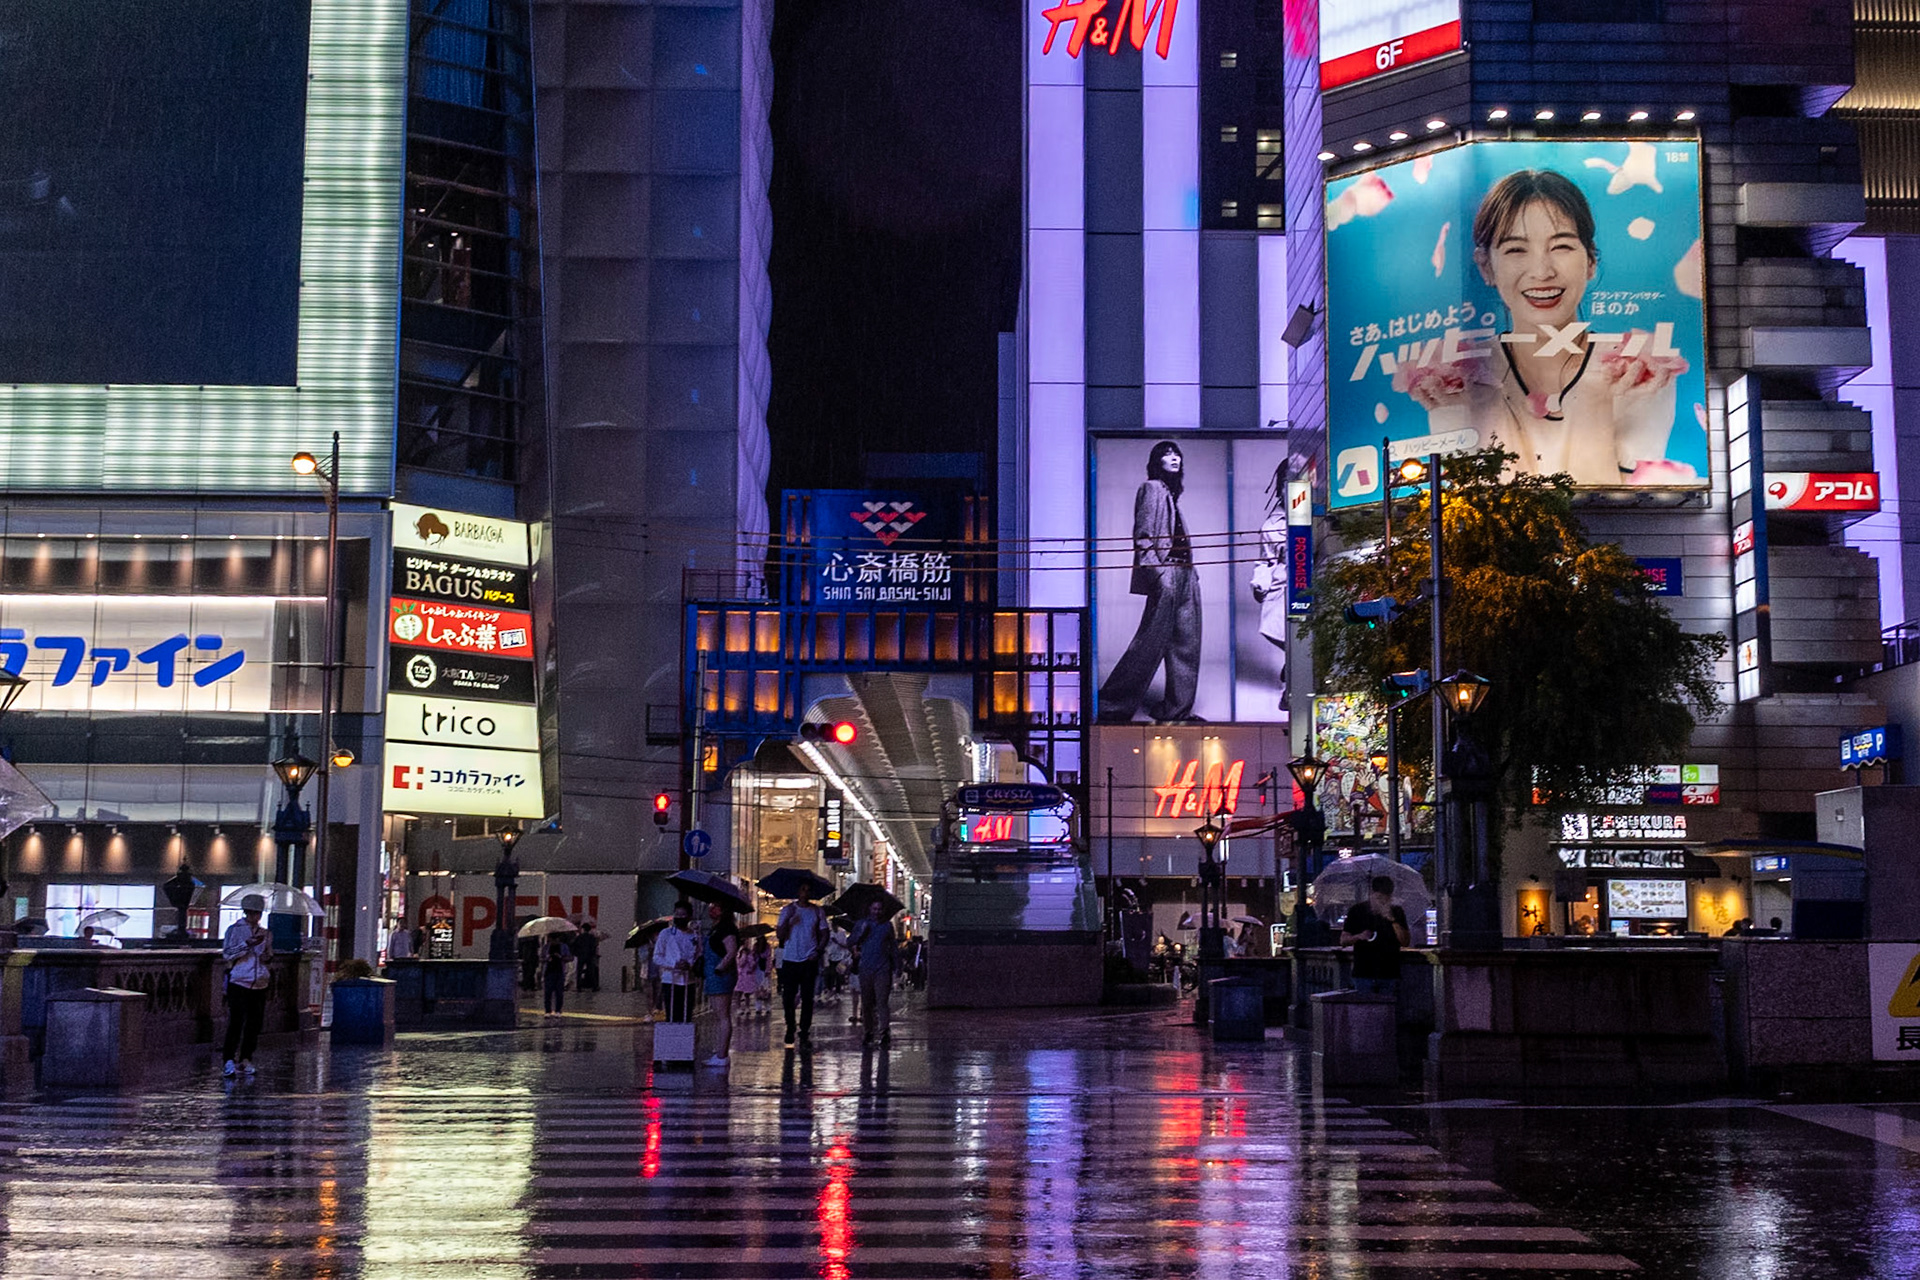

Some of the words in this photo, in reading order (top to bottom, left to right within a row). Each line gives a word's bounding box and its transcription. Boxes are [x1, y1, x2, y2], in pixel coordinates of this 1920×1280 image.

[1042, 0, 1178, 60] H&M
[1375, 40, 1403, 70] 6F
[1591, 301, 1640, 315] ほのか
[1350, 312, 1681, 382] ハッピーメール
[1814, 481, 1874, 501] アコム
[454, 520, 504, 544] BARBACOA
[406, 556, 448, 573] ビリヤード
[822, 552, 952, 583] 心斎橋筋
[1294, 536, 1307, 590] PROMISE
[405, 570, 483, 600] BAGUS
[483, 589, 516, 604] バグース
[420, 603, 501, 622] しゃぶしゃぶバイキング
[426, 616, 497, 651] しゃぶ葉
[0, 628, 246, 688] ラファイン
[441, 667, 510, 684] 大阪TAクリニック
[422, 703, 496, 736] trico
[430, 769, 525, 788] ココカラファイン
[1152, 759, 1245, 819] H&M
[985, 789, 1034, 799] CRYSTA
[1687, 795, 1715, 804] アコム
